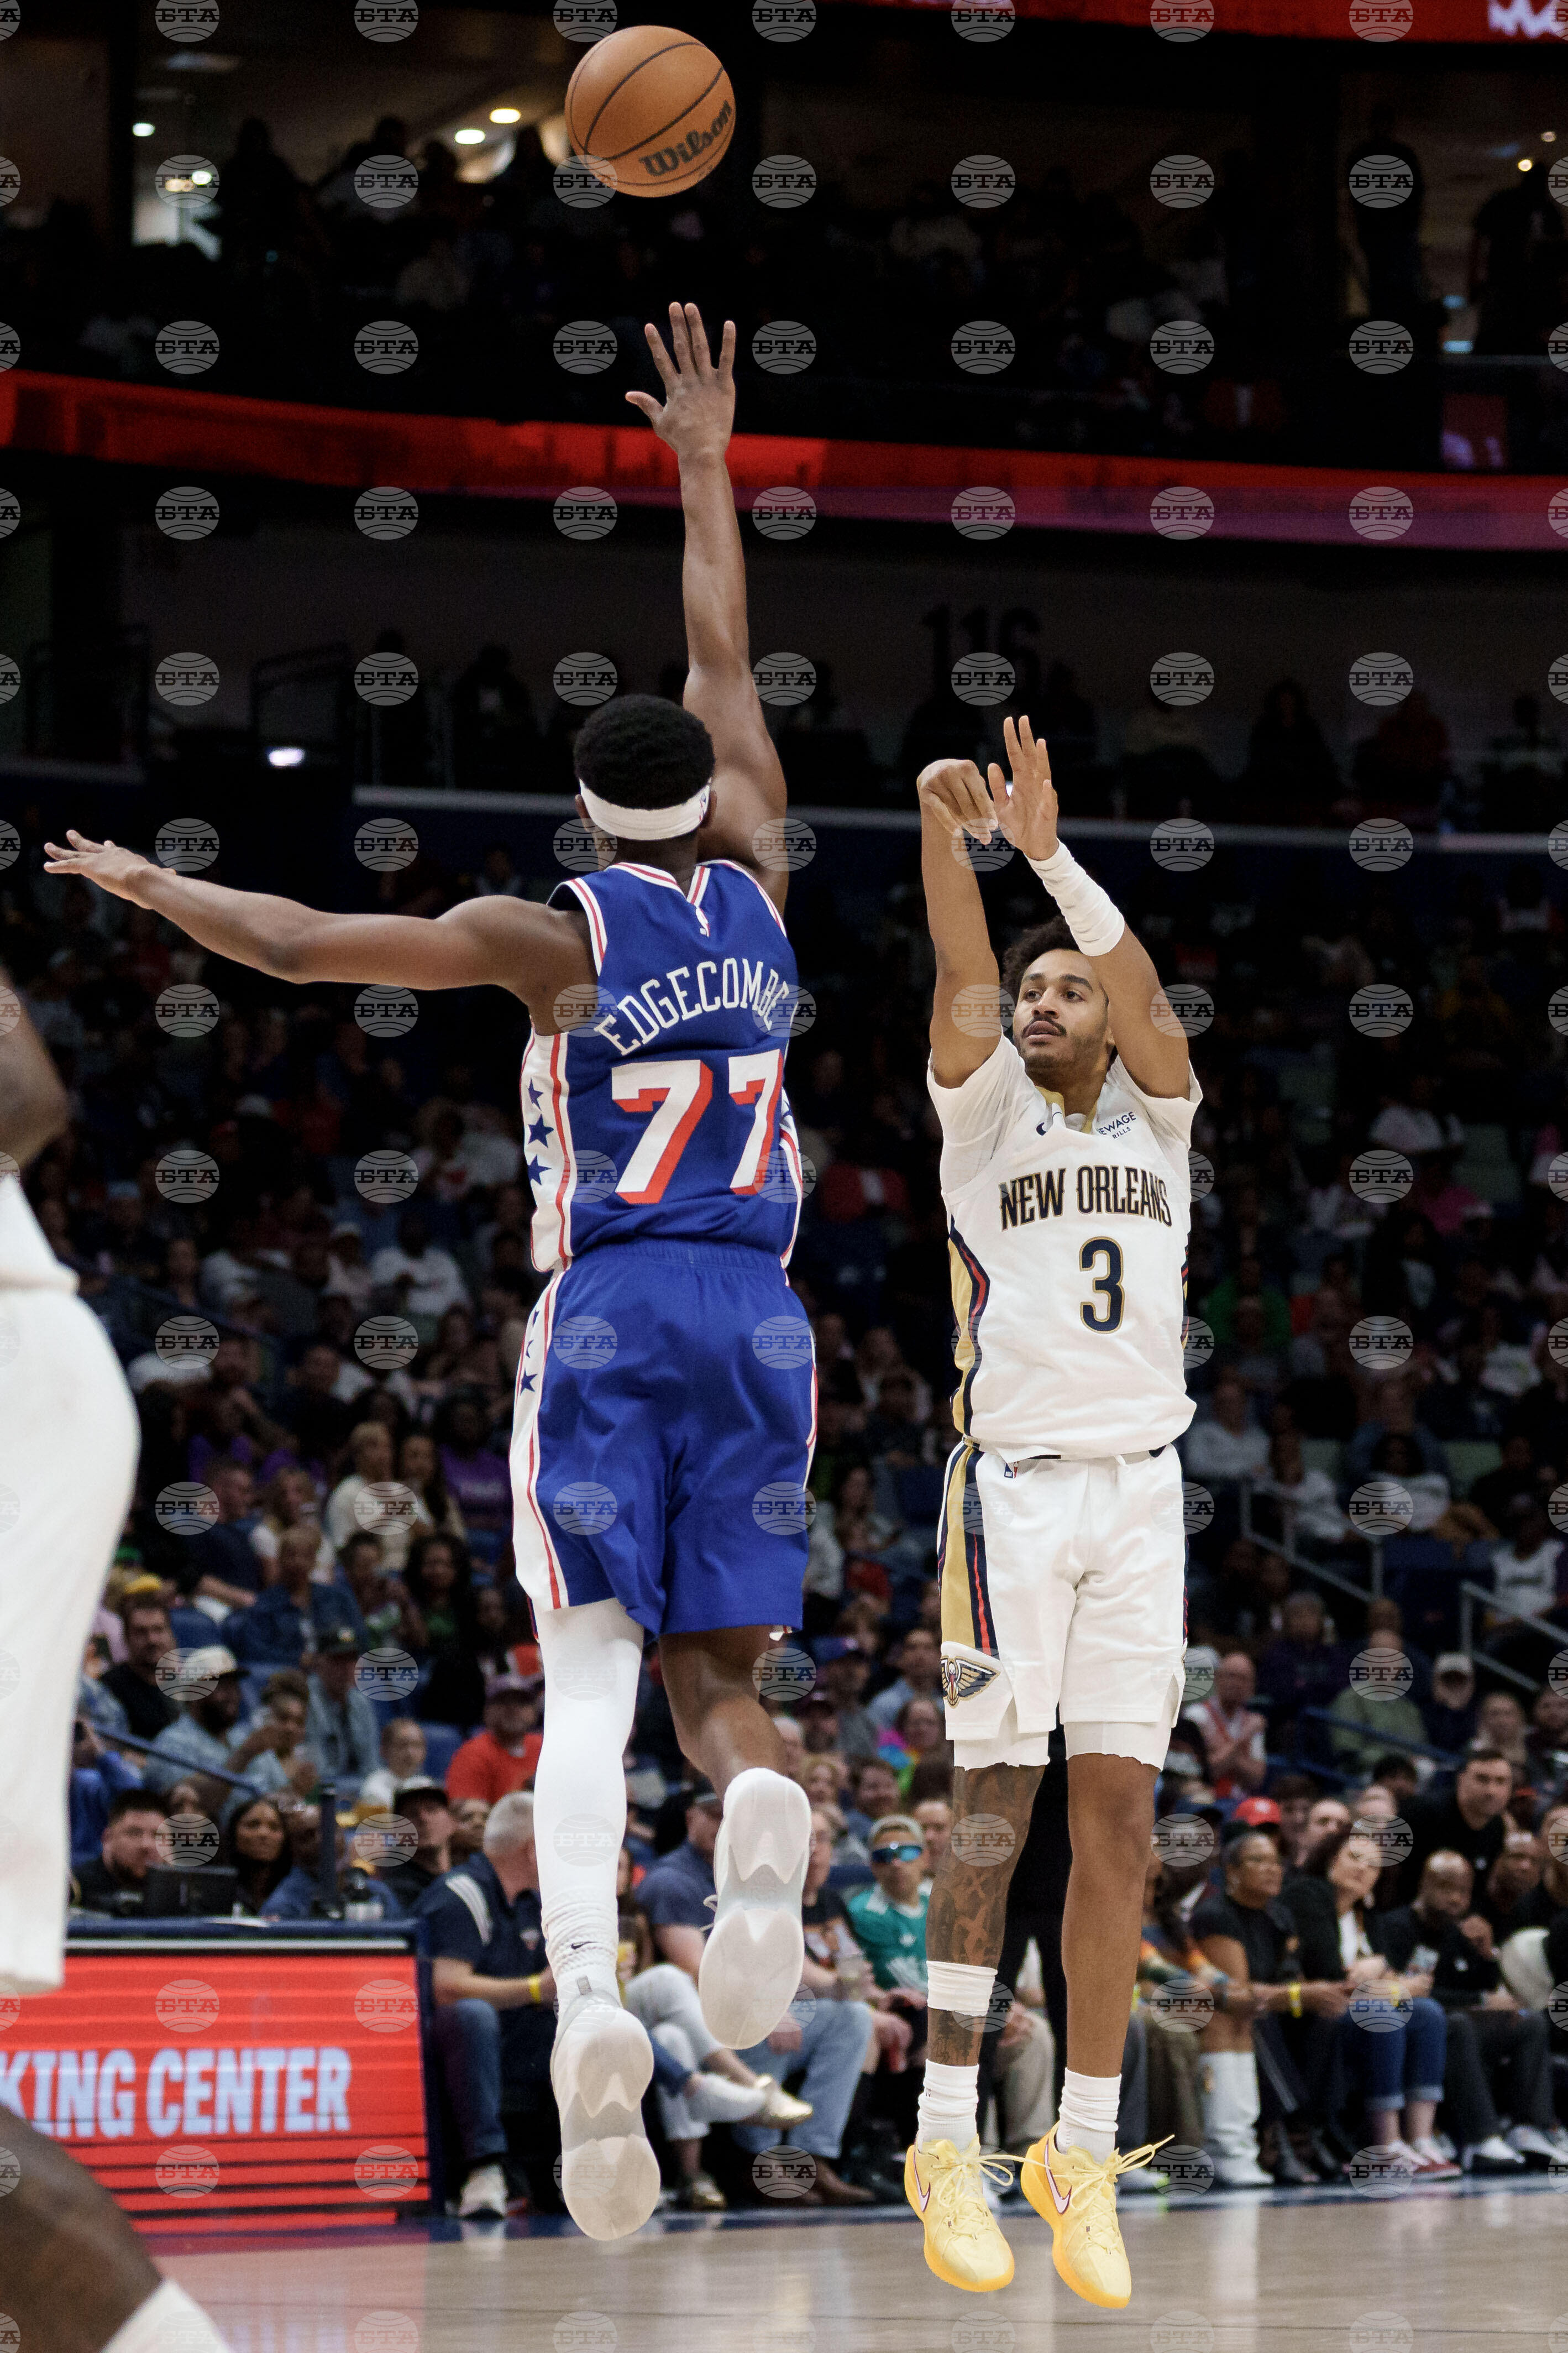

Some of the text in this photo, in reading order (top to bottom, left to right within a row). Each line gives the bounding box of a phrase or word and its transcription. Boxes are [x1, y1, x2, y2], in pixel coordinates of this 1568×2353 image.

[638, 100, 732, 177] Wilson
[594, 958, 789, 1055] EDGECOMBE
[611, 1049, 784, 1204] 77
[1097, 1111, 1136, 1135] EWAGE
[1112, 1126, 1131, 1139] RILLS
[998, 1165, 1172, 1232] NEW ORLEANS
[1079, 1236, 1125, 1334] 3
[0, 2047, 353, 2138] KING CENTER
